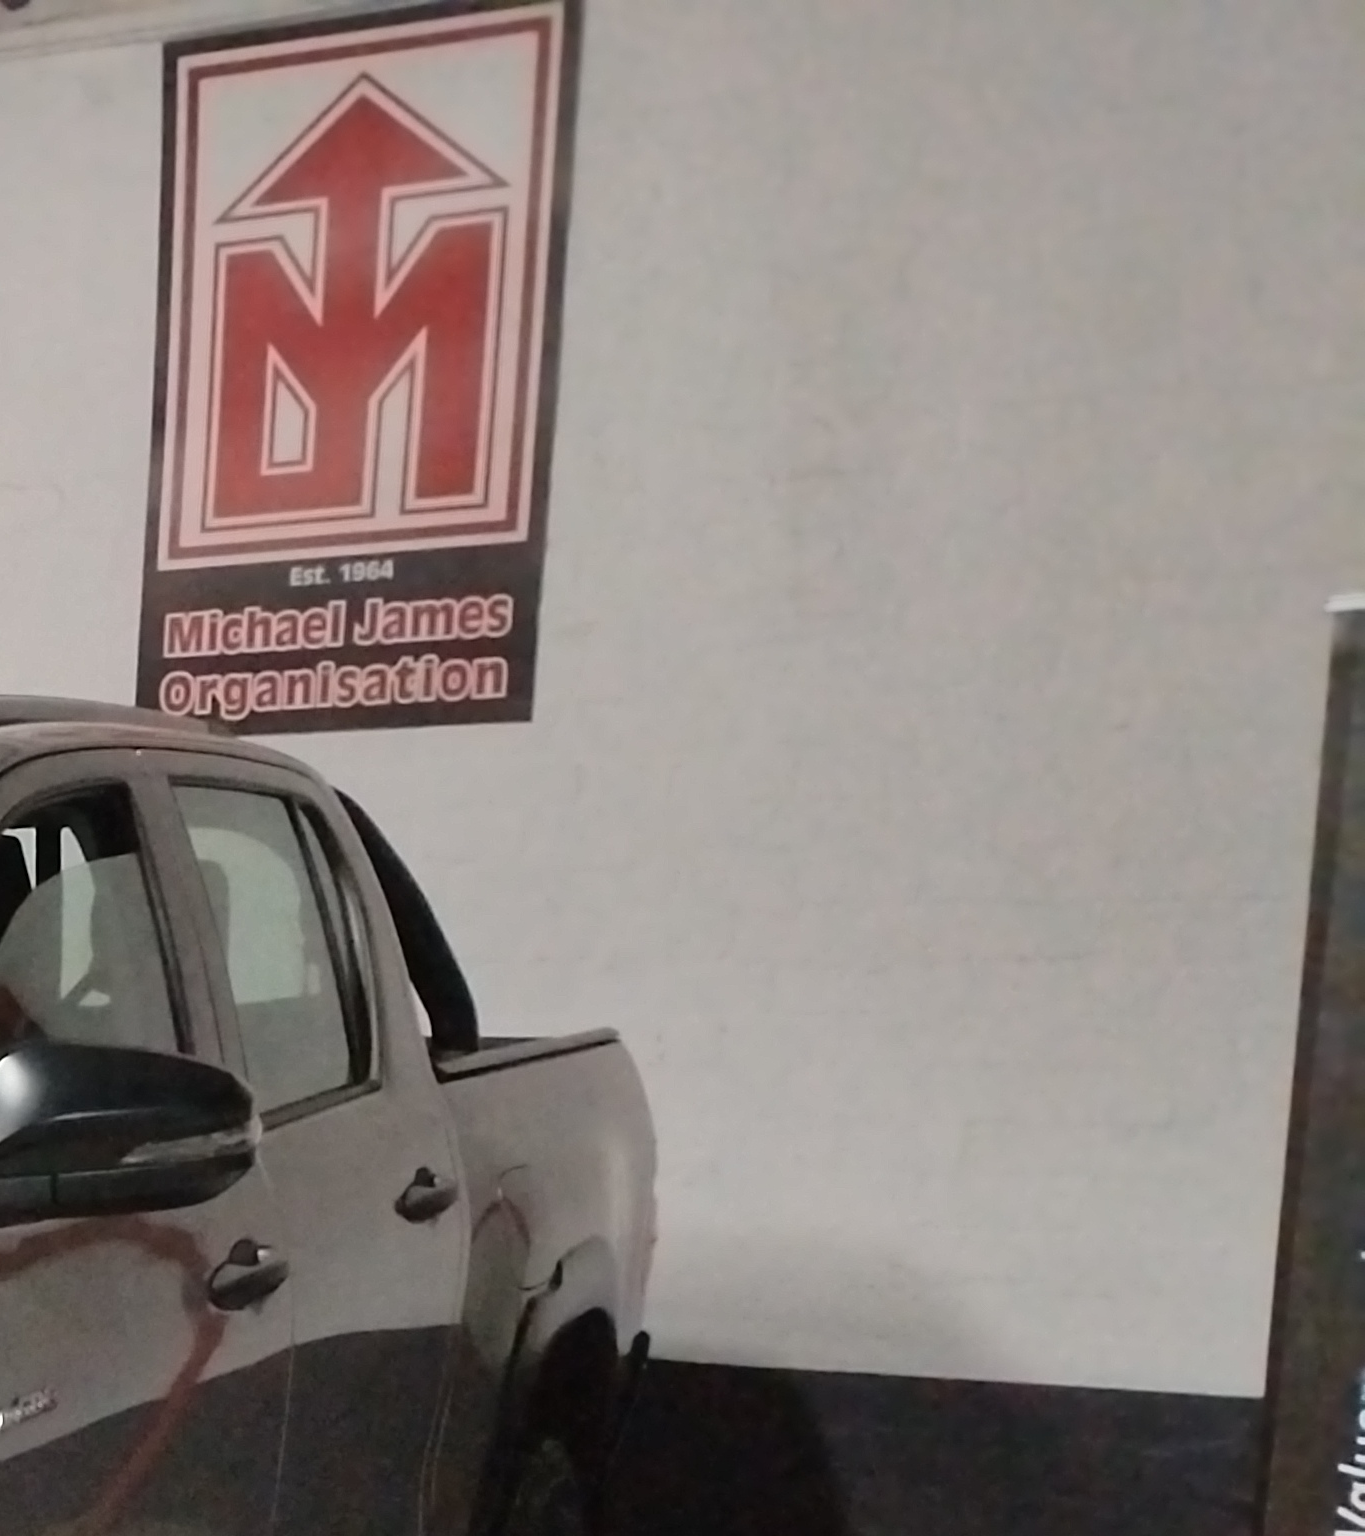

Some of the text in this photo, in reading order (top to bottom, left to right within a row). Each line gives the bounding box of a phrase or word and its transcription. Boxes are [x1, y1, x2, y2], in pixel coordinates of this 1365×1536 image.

[289, 558, 394, 587] Est. 1964
[163, 594, 513, 658] Michael James
[159, 654, 508, 721] Organisation
